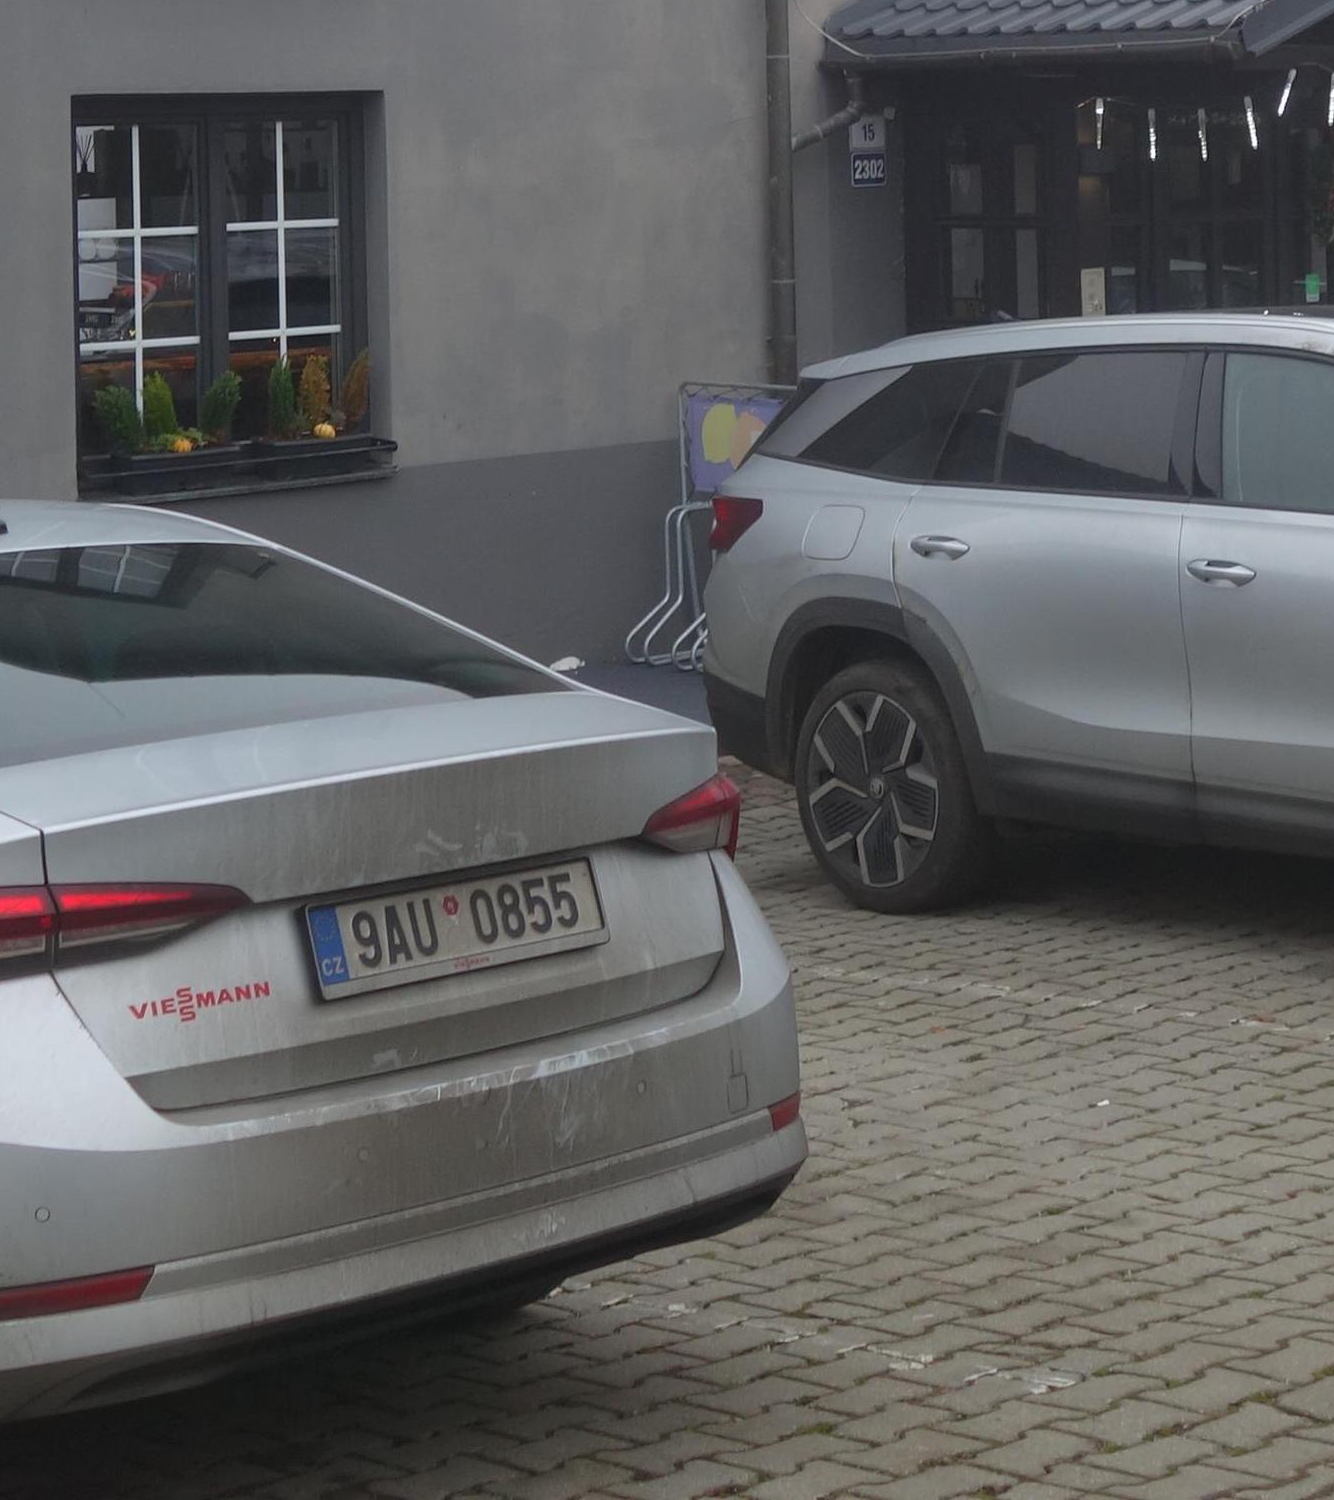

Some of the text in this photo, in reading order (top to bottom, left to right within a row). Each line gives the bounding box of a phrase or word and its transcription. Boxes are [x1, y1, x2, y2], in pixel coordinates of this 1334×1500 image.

[862, 123, 875, 142] 15
[854, 159, 884, 179] 2302
[351, 872, 579, 969] 9AU 0855
[321, 956, 344, 976] CZ
[128, 981, 271, 1023] VIESSMANN
